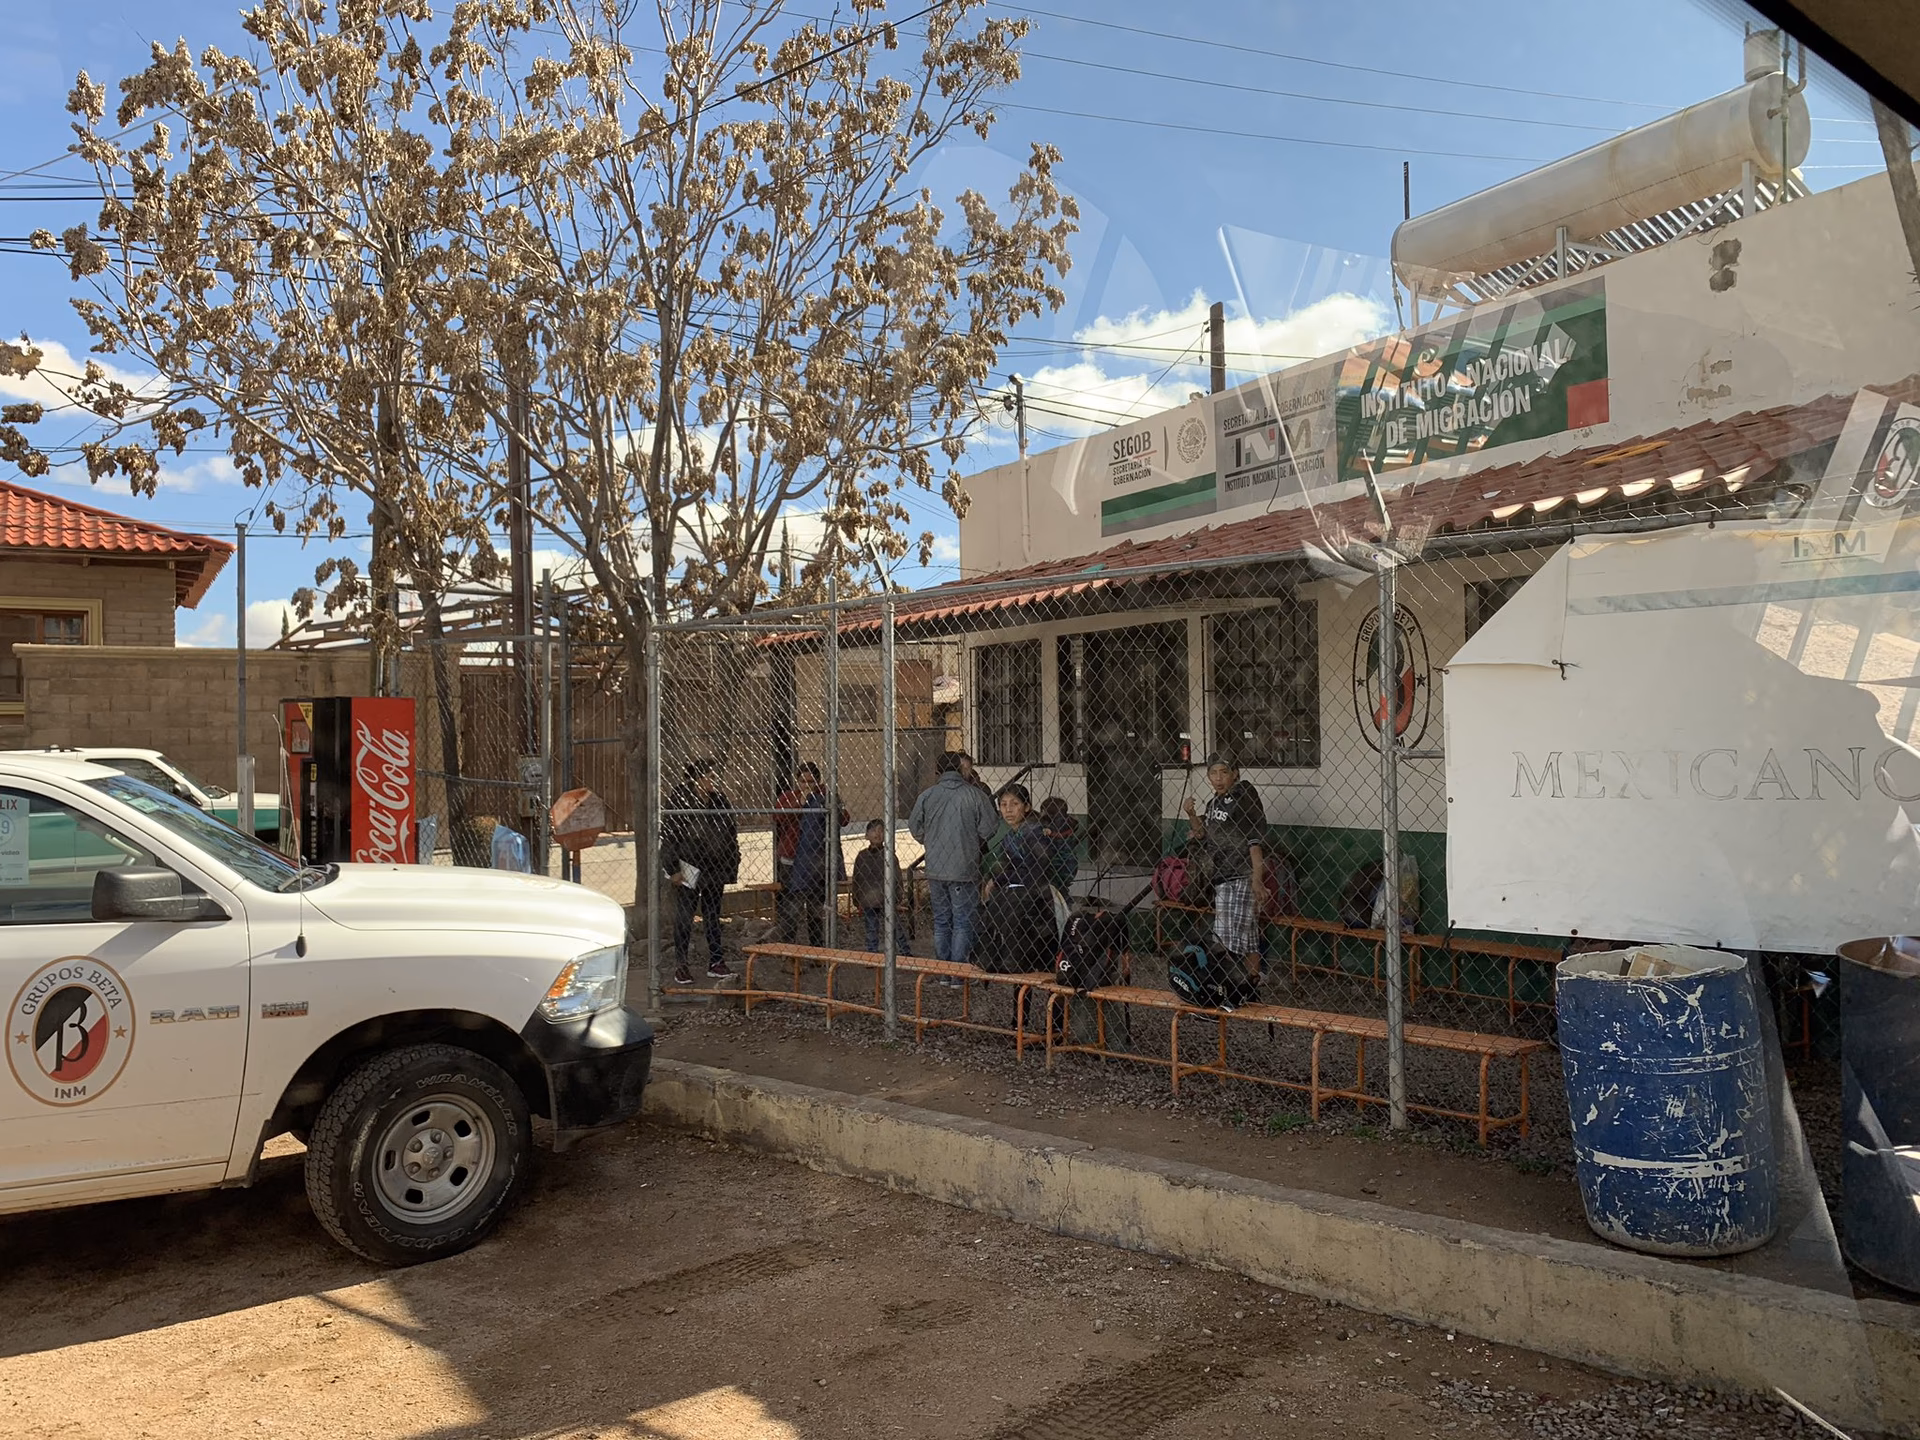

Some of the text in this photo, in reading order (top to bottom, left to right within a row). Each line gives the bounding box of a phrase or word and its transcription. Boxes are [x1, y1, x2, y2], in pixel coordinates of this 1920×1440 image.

[1466, 338, 1567, 387] NACIONAL
[1223, 409, 1260, 430] SECRETAA
[1386, 383, 1532, 448] DE MIGRACIÓN
[1113, 430, 1151, 460] SEGOB
[1224, 475, 1251, 492] INSTITUTO
[1252, 467, 1277, 486] NACIONAL
[21, 966, 122, 1015] GRUPOS BETA
[150, 1004, 240, 1024] RAM
[54, 1085, 87, 1099] INM
[416, 1073, 518, 1137] WRANGLER
